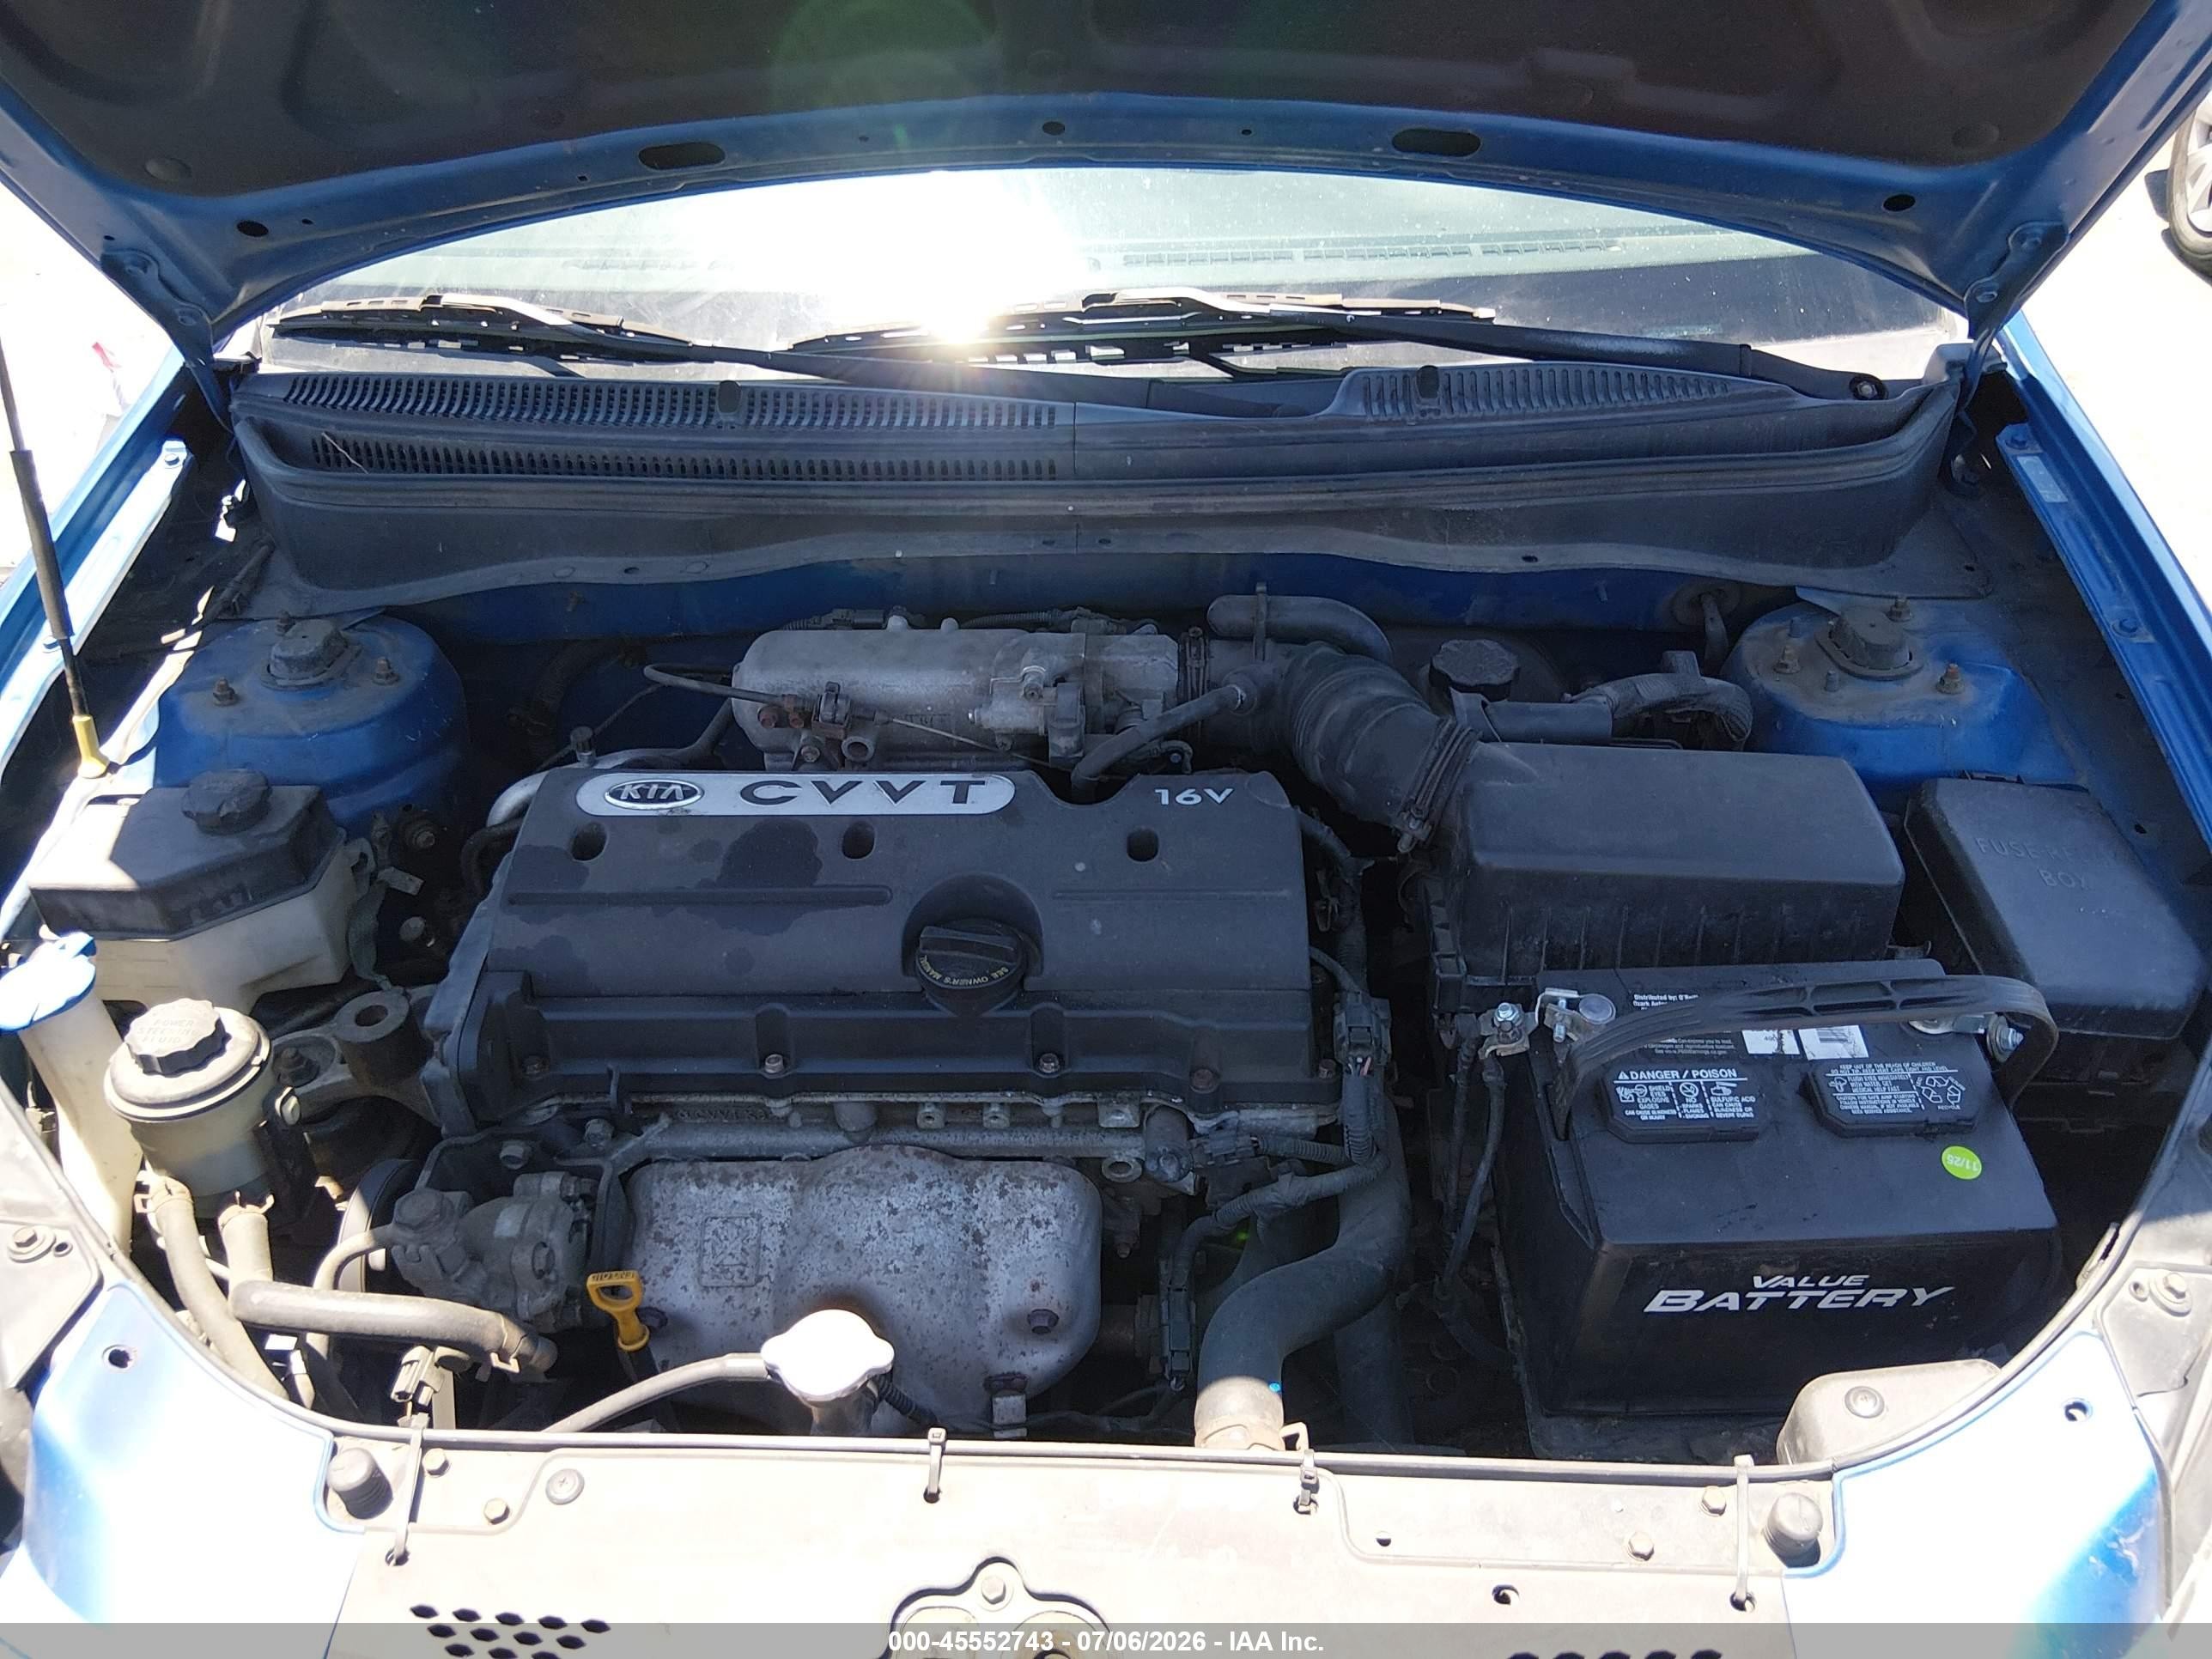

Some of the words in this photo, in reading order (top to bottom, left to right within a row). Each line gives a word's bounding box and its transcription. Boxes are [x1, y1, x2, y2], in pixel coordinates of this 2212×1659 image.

[618, 783, 686, 800] KIA
[739, 780, 987, 805] CVVT
[1154, 788, 1234, 805] 16V
[990, 966, 1009, 979] SEE
[944, 975, 988, 986] OWNER'S
[1630, 1070, 1680, 1079] DANGER
[1692, 1068, 1738, 1079] POISON
[1752, 1274, 1870, 1288] VALUE
[1643, 1286, 1955, 1312] BATTERY
